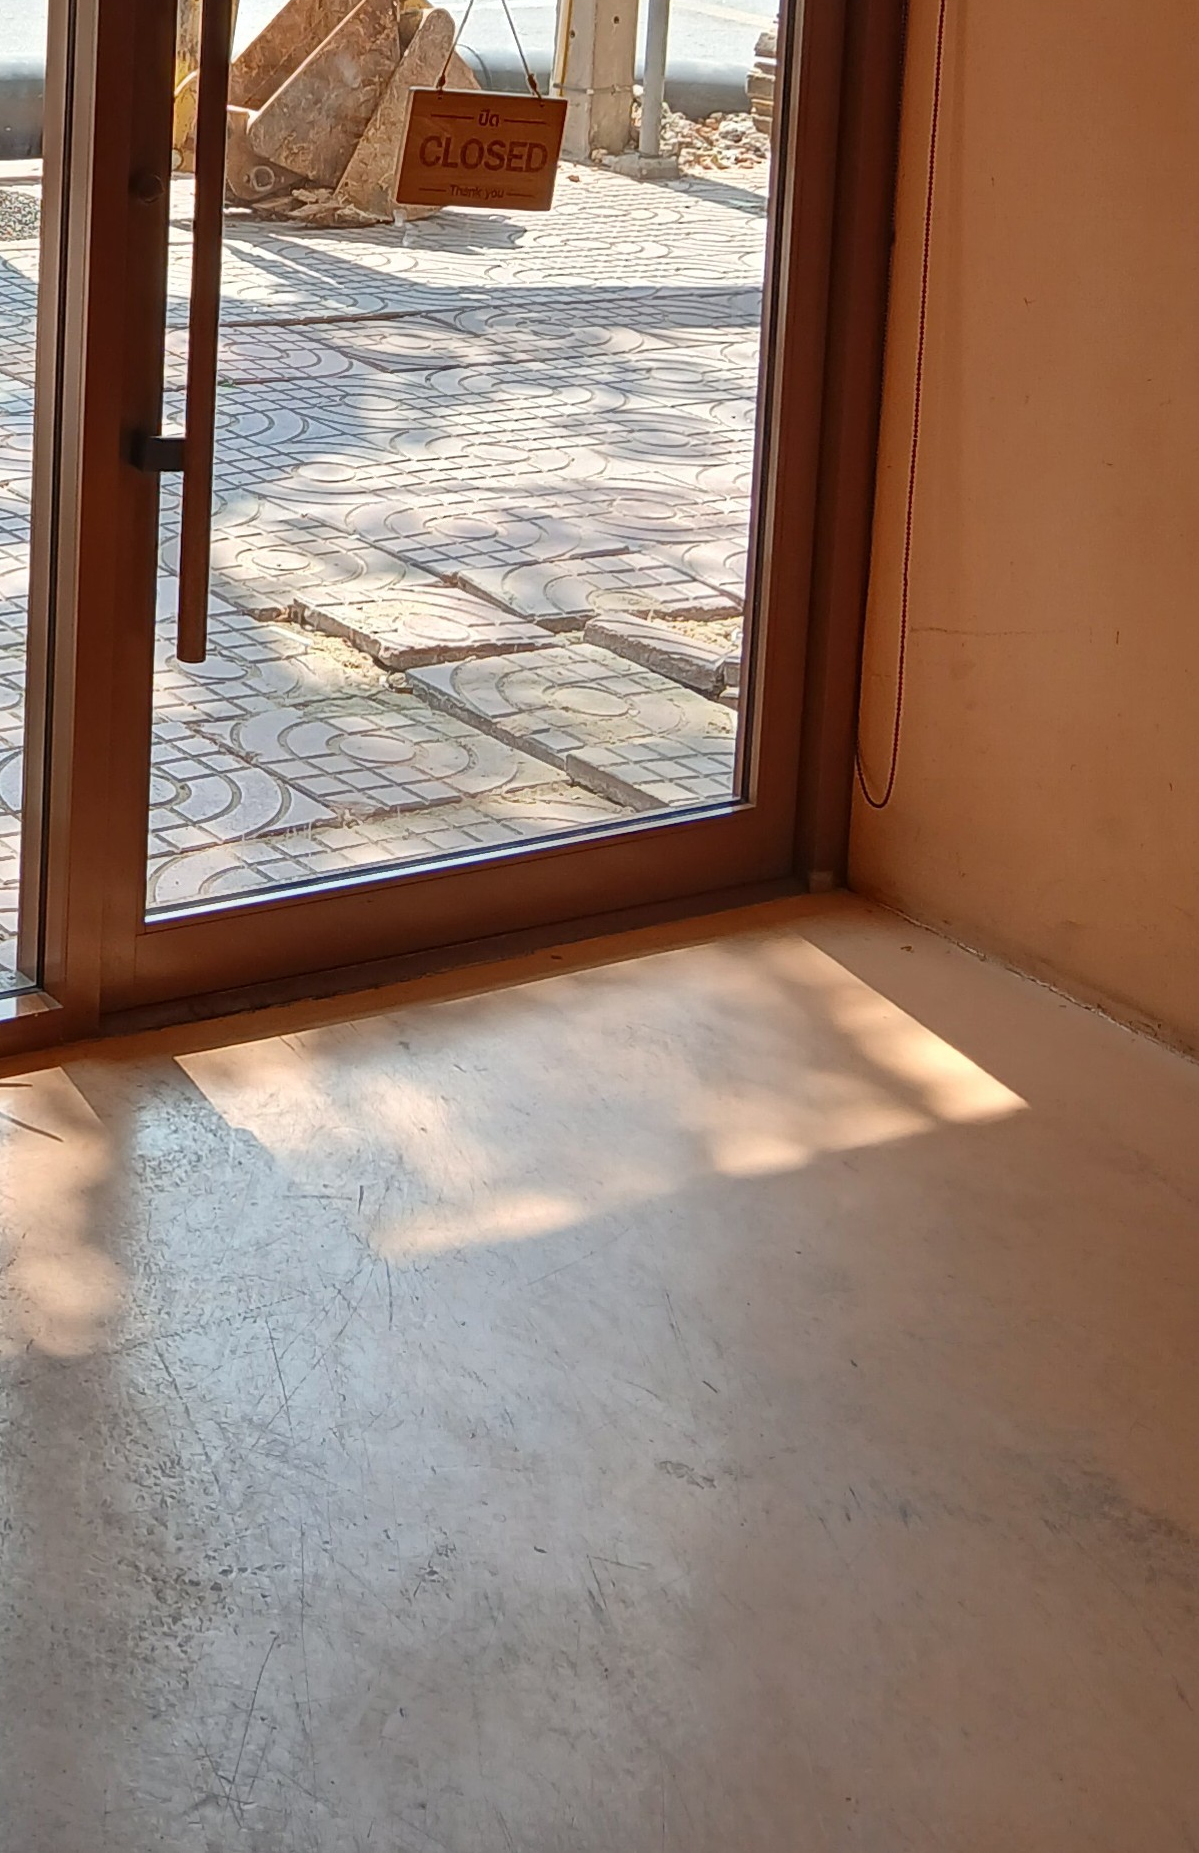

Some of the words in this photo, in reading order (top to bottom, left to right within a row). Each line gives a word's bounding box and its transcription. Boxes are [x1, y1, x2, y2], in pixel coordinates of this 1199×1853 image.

[418, 134, 549, 173] CLOSED
[449, 184, 482, 198] Thank
[484, 187, 505, 200] you
